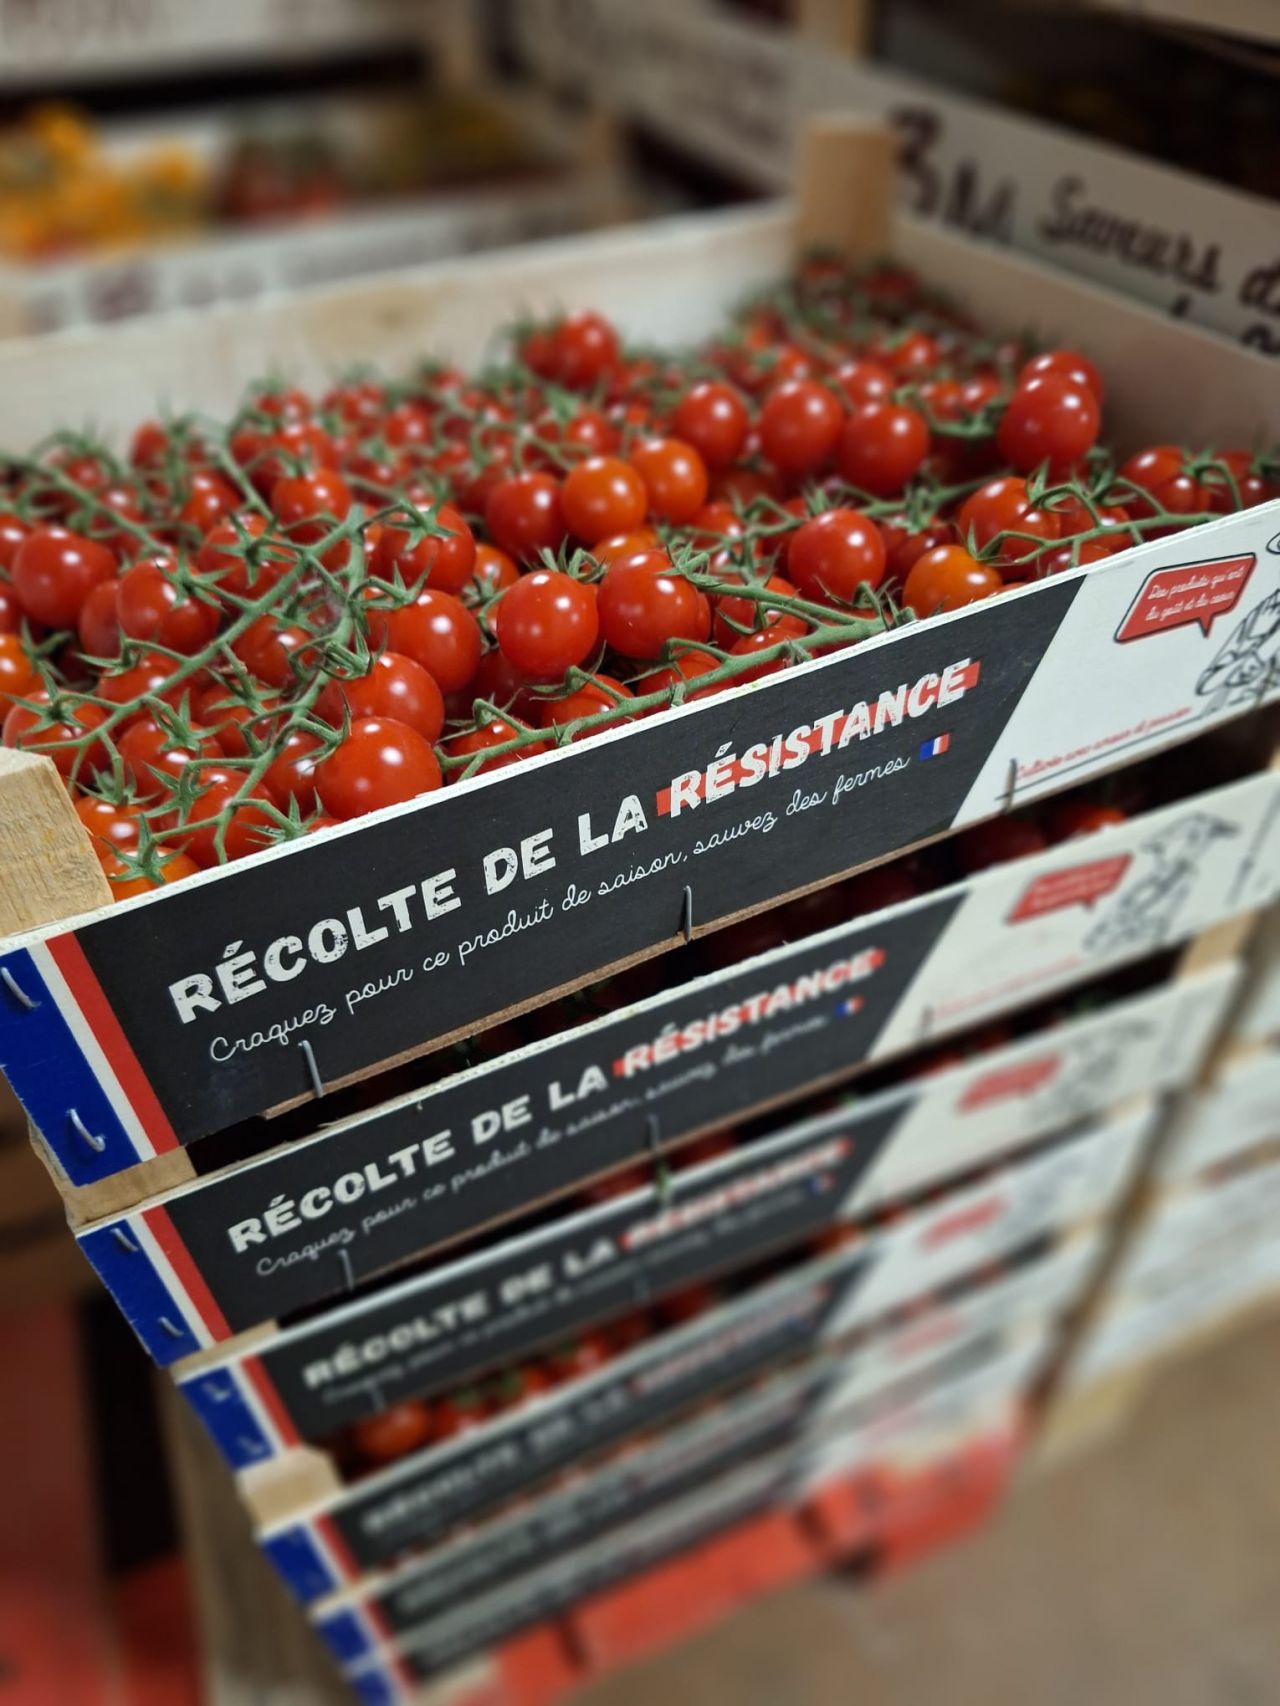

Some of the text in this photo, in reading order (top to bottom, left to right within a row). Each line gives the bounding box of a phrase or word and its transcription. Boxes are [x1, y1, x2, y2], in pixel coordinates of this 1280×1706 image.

[168, 657, 972, 1024] RÉCOLTE DE LA RÉSISTANCE
[209, 755, 912, 1062] Craquez pour ce produit de saison, sauvez des fermes
[227, 1129, 456, 1254] RÉCOLTE
[470, 1095, 533, 1145] DE
[548, 1064, 608, 1111] LA
[621, 947, 877, 1078] RÉSISTANCE
[256, 1227, 356, 1276] Craquez
[361, 1195, 417, 1234] pour
